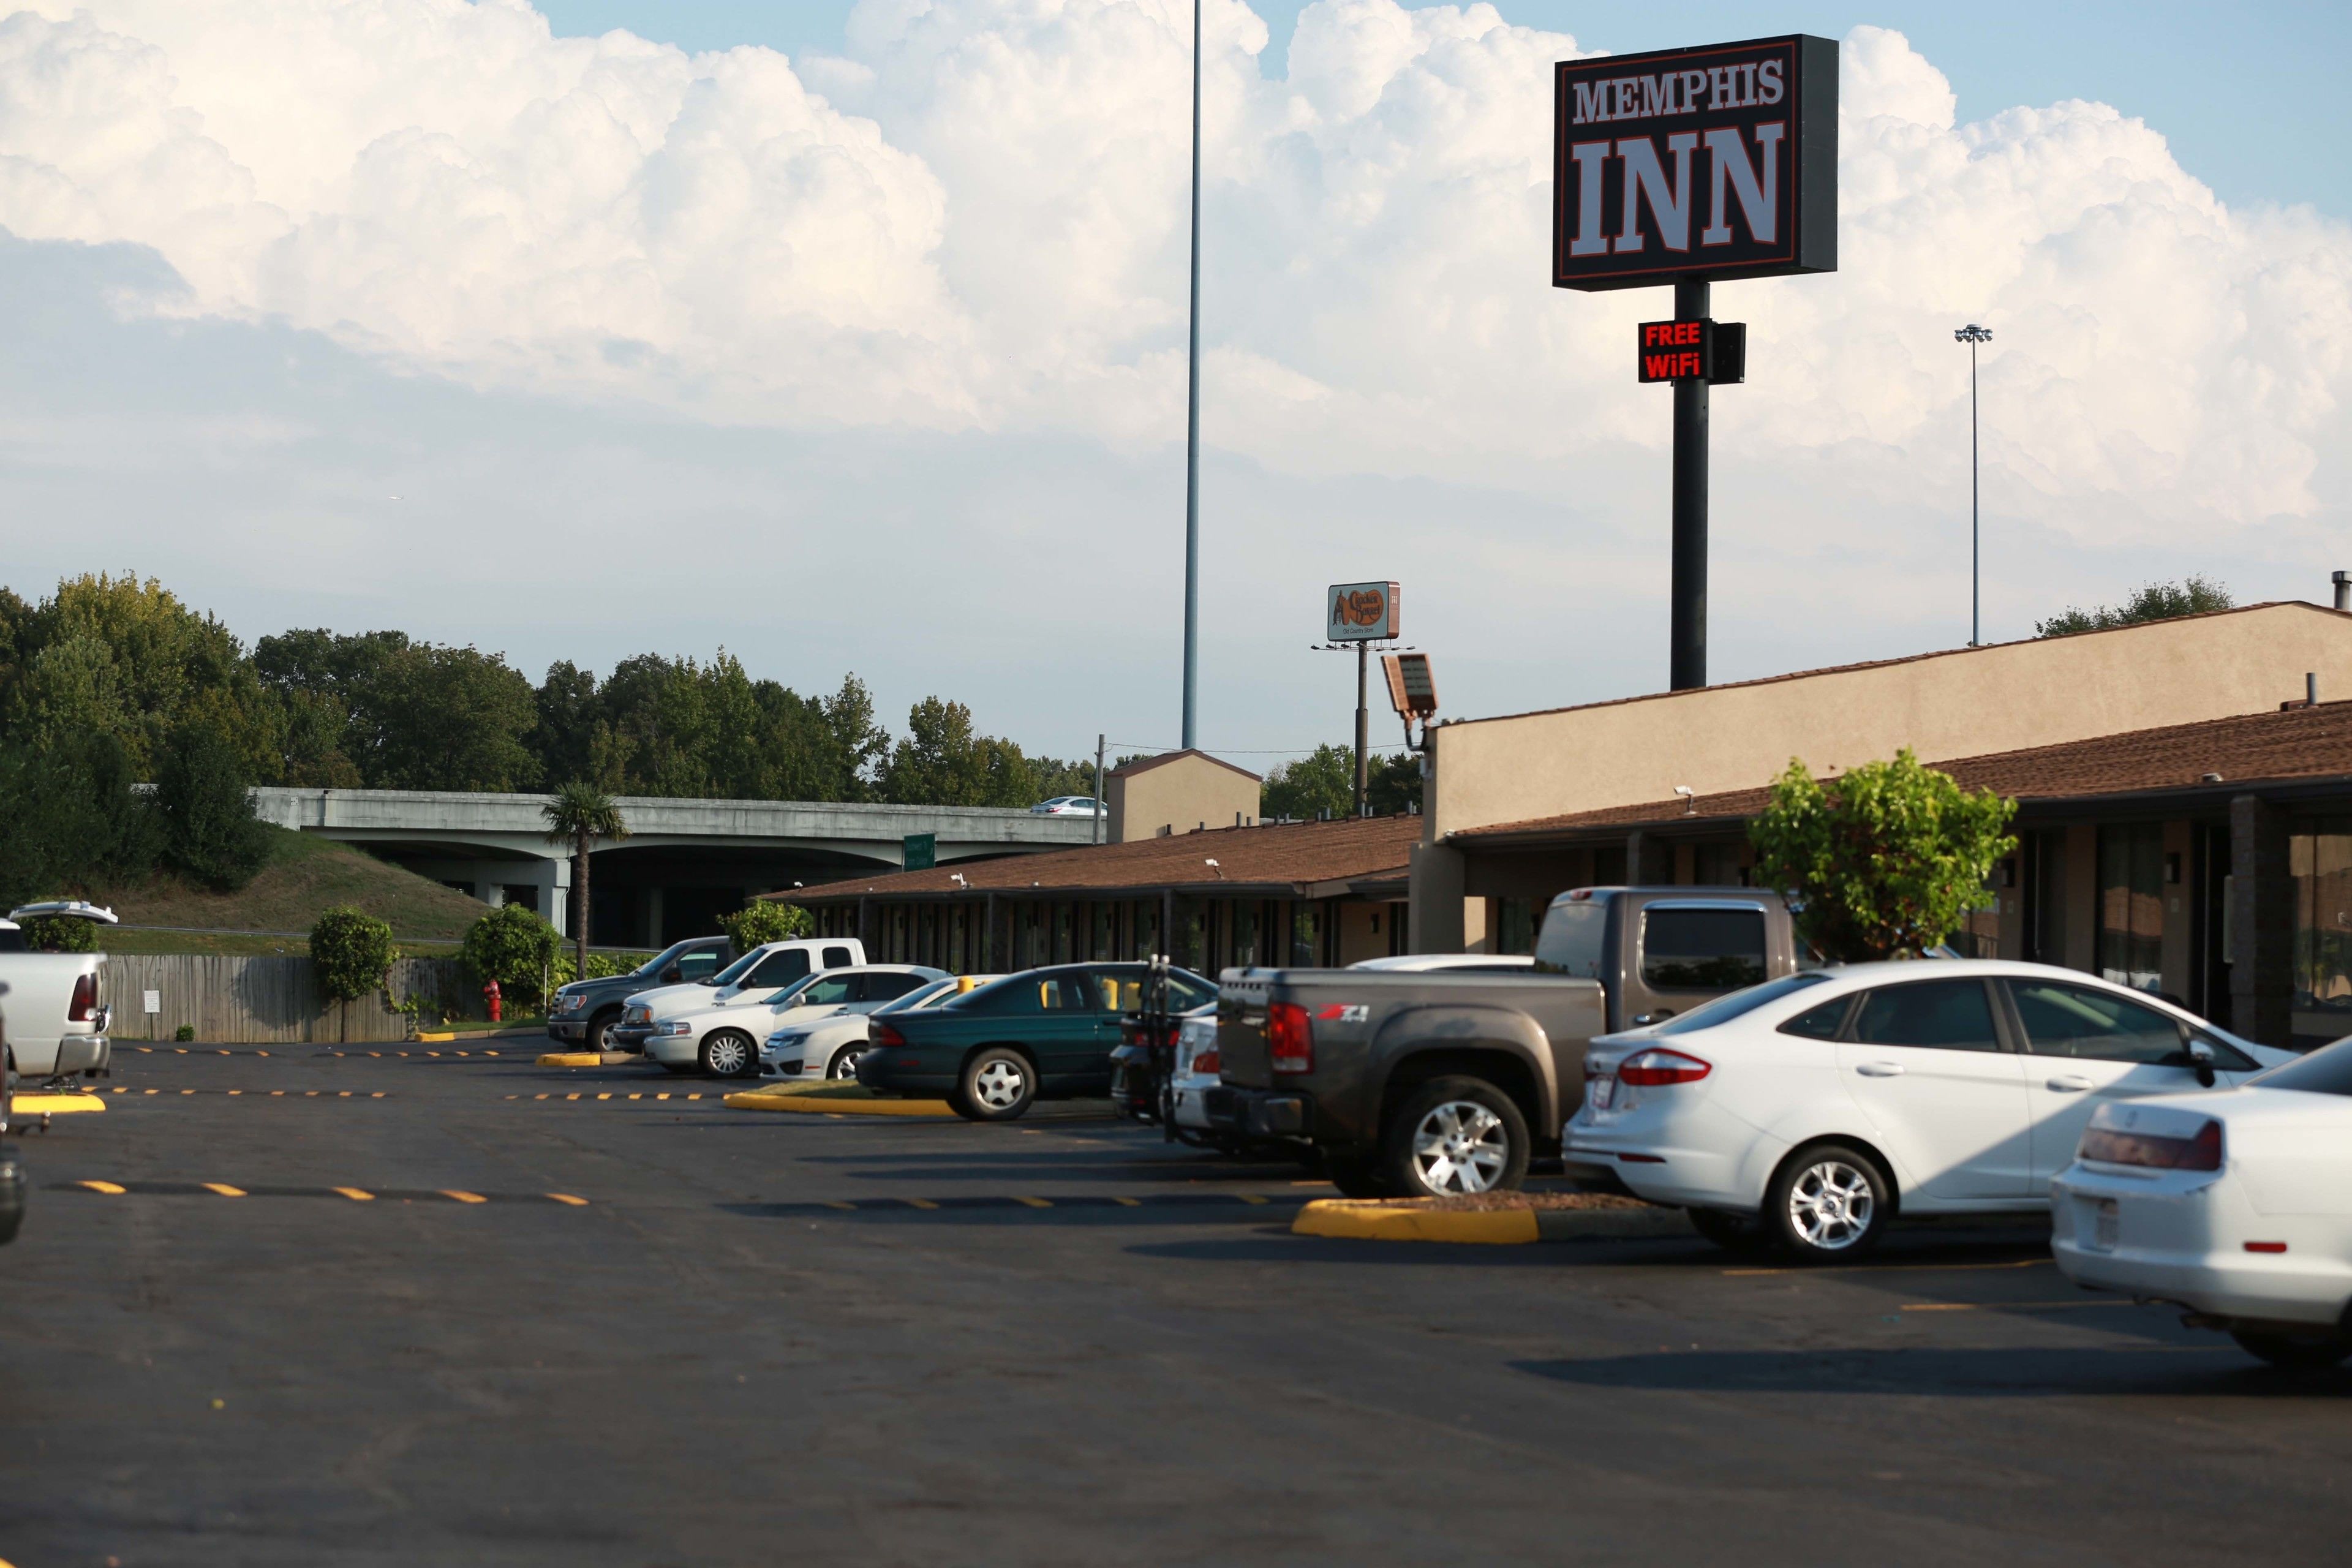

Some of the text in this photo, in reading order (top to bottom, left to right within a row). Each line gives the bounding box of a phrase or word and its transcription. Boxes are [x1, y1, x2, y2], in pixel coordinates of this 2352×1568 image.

[1572, 59, 1784, 124] MEMPHIS
[1570, 121, 1785, 258] INN
[1645, 322, 1700, 347] FREE
[1645, 352, 1700, 379] WiFi
